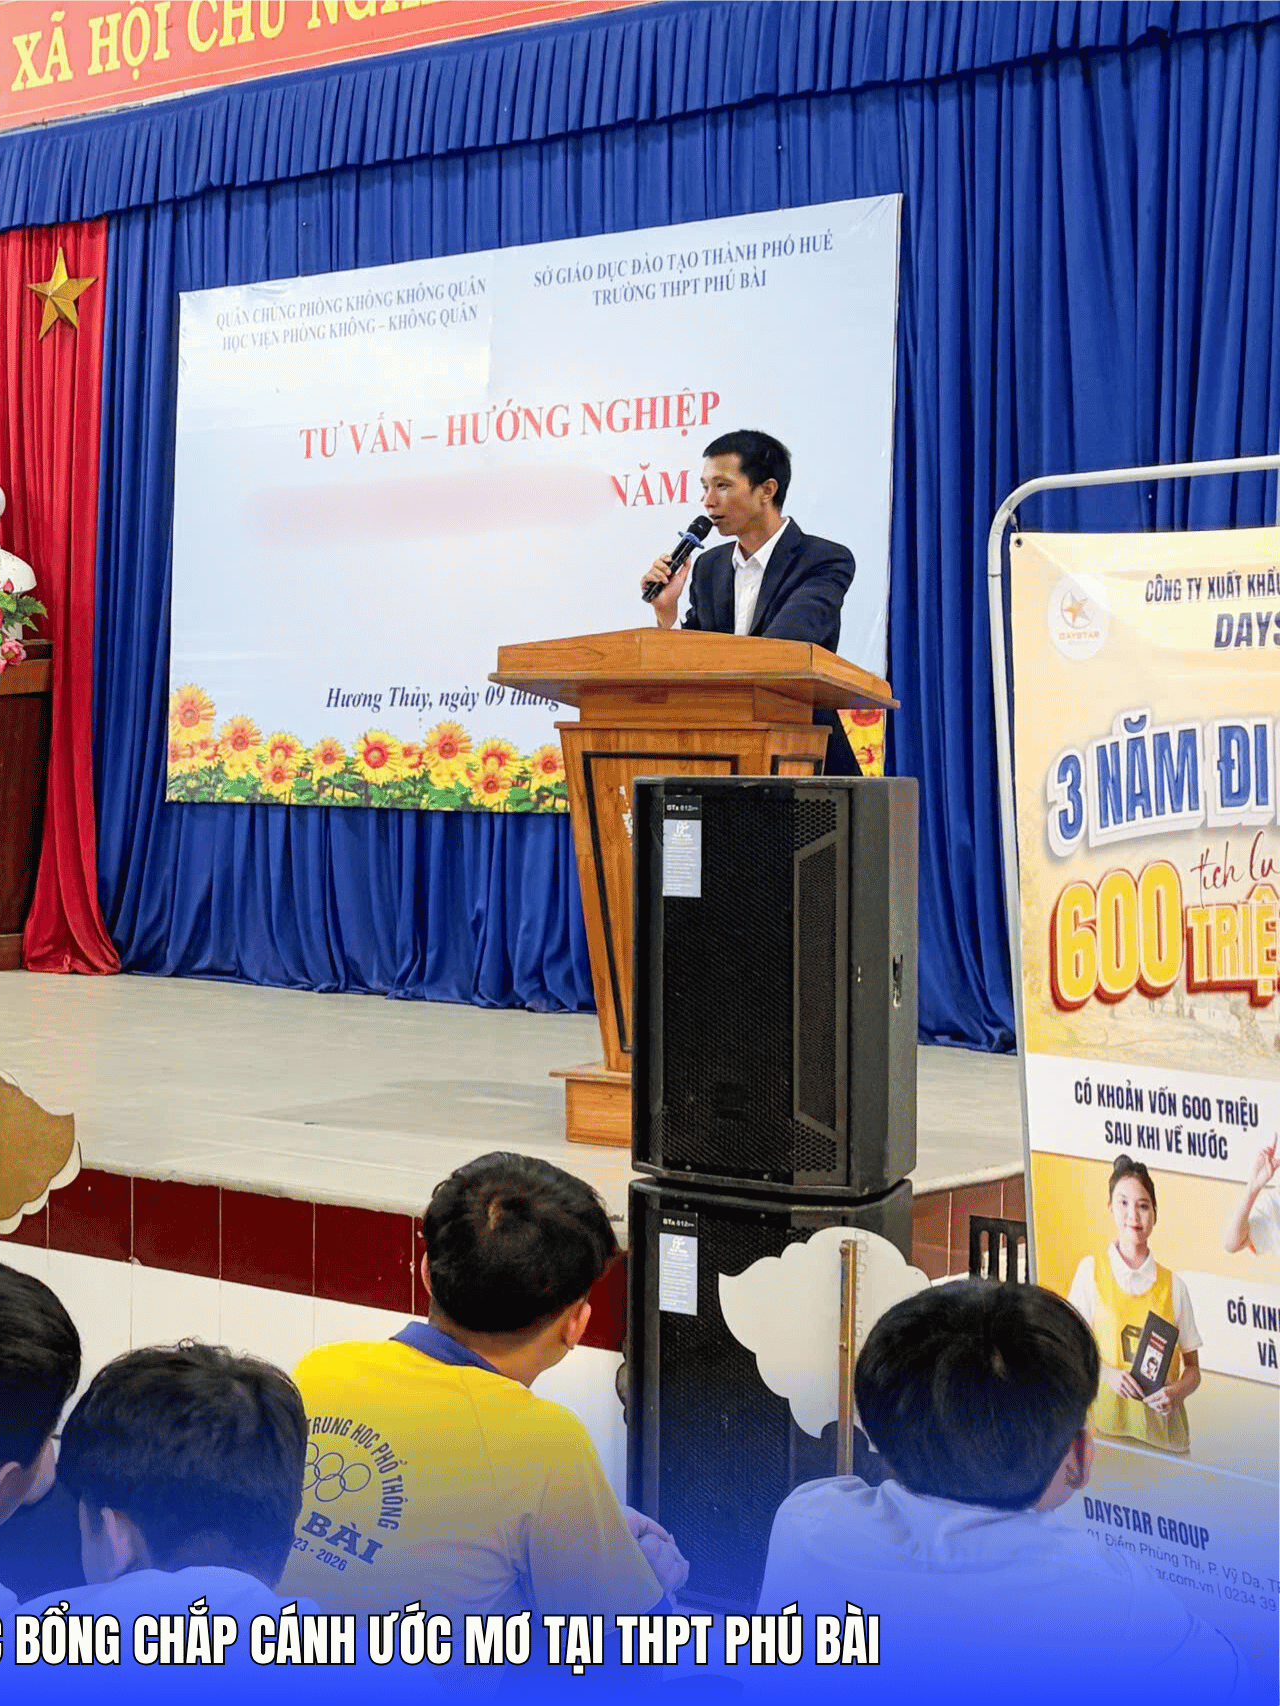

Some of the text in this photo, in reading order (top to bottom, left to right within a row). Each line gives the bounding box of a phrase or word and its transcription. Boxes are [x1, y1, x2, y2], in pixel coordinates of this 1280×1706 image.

[11, 10, 73, 92] XÃ
[88, 0, 171, 81] HỘI
[556, 261, 594, 285] GIÁO
[597, 259, 628, 282] DỤC
[631, 252, 663, 276] ĐÀO
[667, 251, 699, 274] TẠO
[703, 241, 757, 266] THÀNH
[346, 288, 393, 312] KHÔNG
[397, 281, 445, 306] KHÔNG
[448, 274, 486, 302] QUÂN
[592, 265, 767, 306] TRƯỜNG THPT PHÚ BÀI
[329, 316, 376, 339] KHÔNG
[389, 308, 437, 331] KHÔNG
[440, 301, 478, 328] QUÂN
[299, 386, 721, 460] TƯ VẤN HƯỚNG NGHIỆP
[610, 462, 690, 508] NĂM
[1145, 573, 1182, 602] CÔNG
[1187, 577, 1202, 600] TY
[1208, 570, 1241, 600] XUẤT
[325, 687, 383, 713] Hương
[438, 685, 480, 712] ngày
[485, 685, 505, 706] 09
[1055, 713, 1270, 842] 3 NĂM ĐI
[1051, 860, 1184, 1010] 600
[1074, 1077, 1259, 1133] CÓ KHOẢN VỐN 600 TRIỆU
[1104, 1119, 1228, 1161] SAU KHI VỀ NƯỚC
[1227, 1295, 1247, 1326] CÓ
[1257, 1337, 1278, 1370] VÀ
[350, 1422, 381, 1450] HỌC
[377, 1474, 408, 1530] THÔNG
[301, 1511, 383, 1565] BÀI
[1083, 1496, 1210, 1550] DAYSTAR GROUP
[316, 1548, 348, 1572] 2026
[1225, 1586, 1256, 1606] 0234
